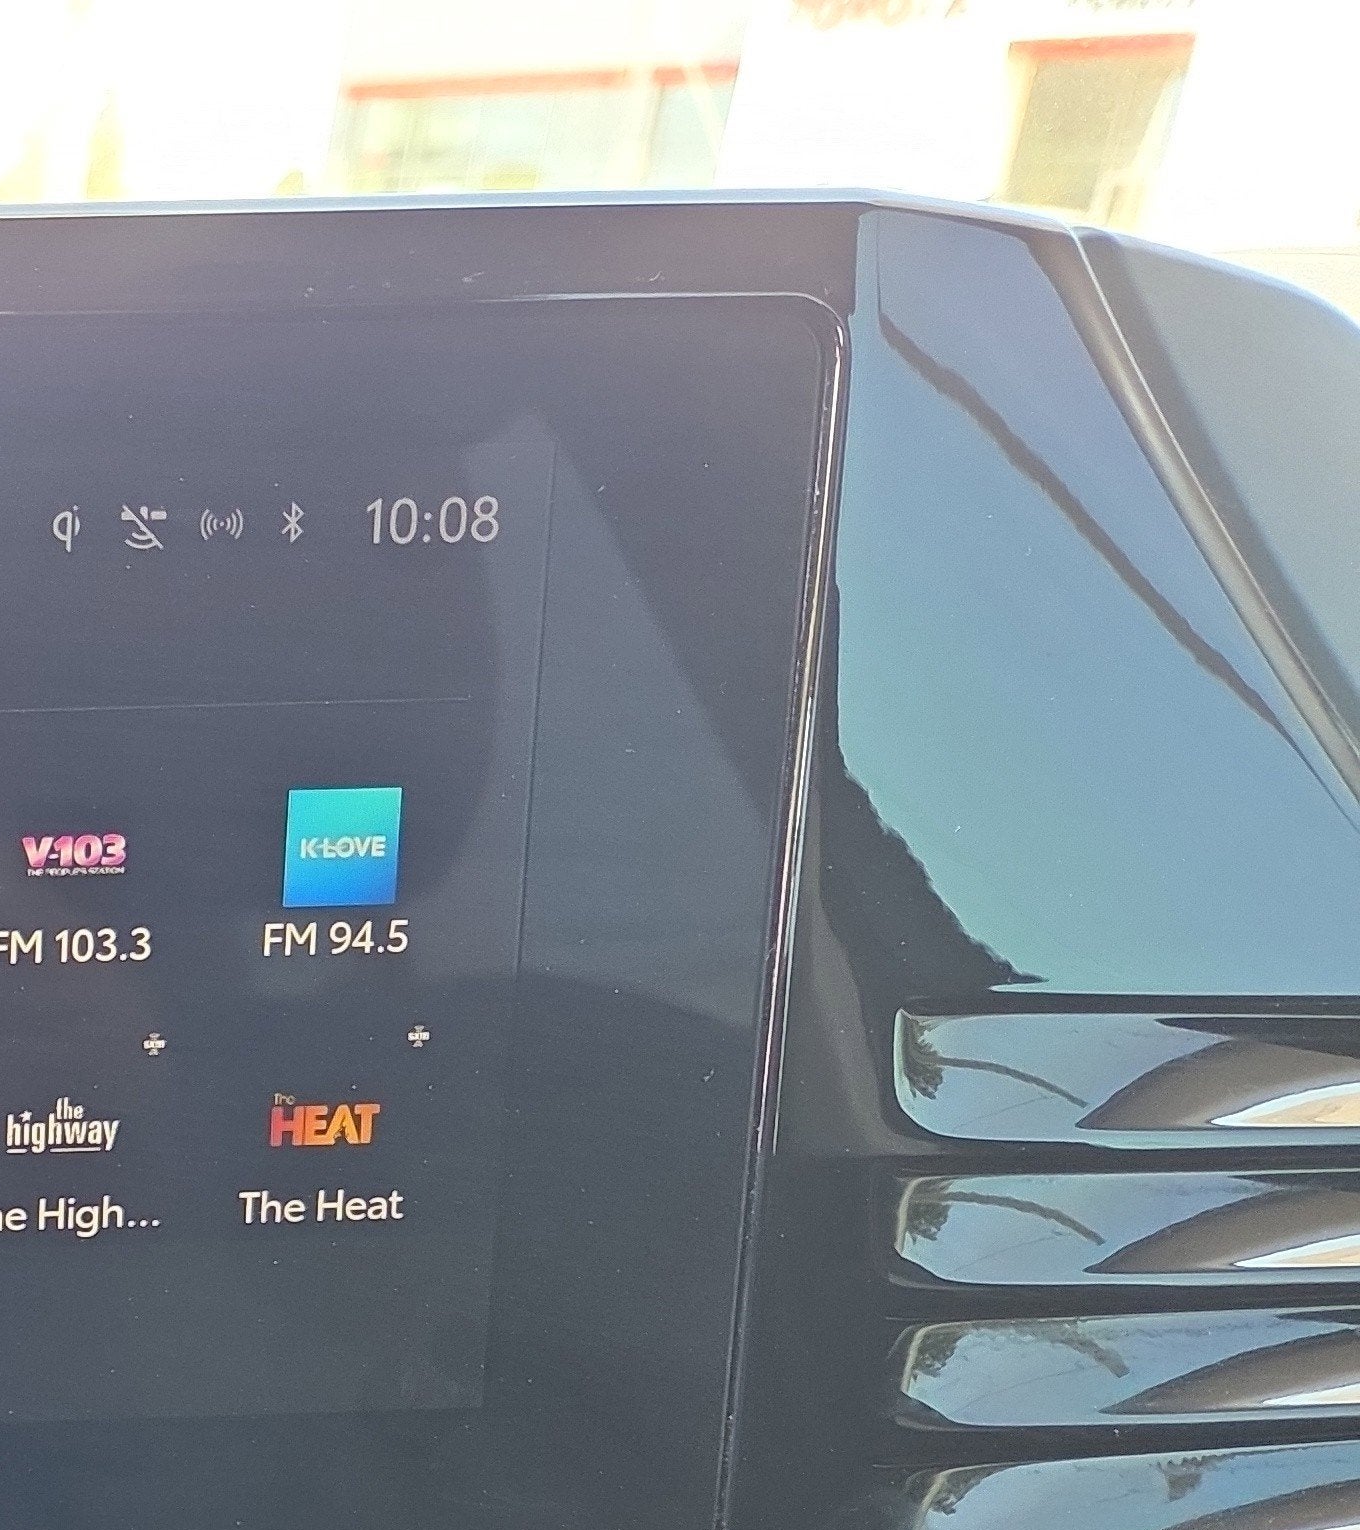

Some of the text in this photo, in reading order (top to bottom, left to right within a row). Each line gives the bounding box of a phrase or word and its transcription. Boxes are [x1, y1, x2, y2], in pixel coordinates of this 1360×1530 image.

[366, 494, 500, 545] 10:08
[22, 833, 127, 867] V-103
[55, 927, 152, 963] 103.3
[263, 919, 409, 957] FM 94.5
[56, 1097, 84, 1119] the
[270, 1104, 380, 1146] HEAT
[6, 1111, 121, 1153] highway
[38, 1195, 160, 1238] High...
[238, 1189, 404, 1224] The Heat
